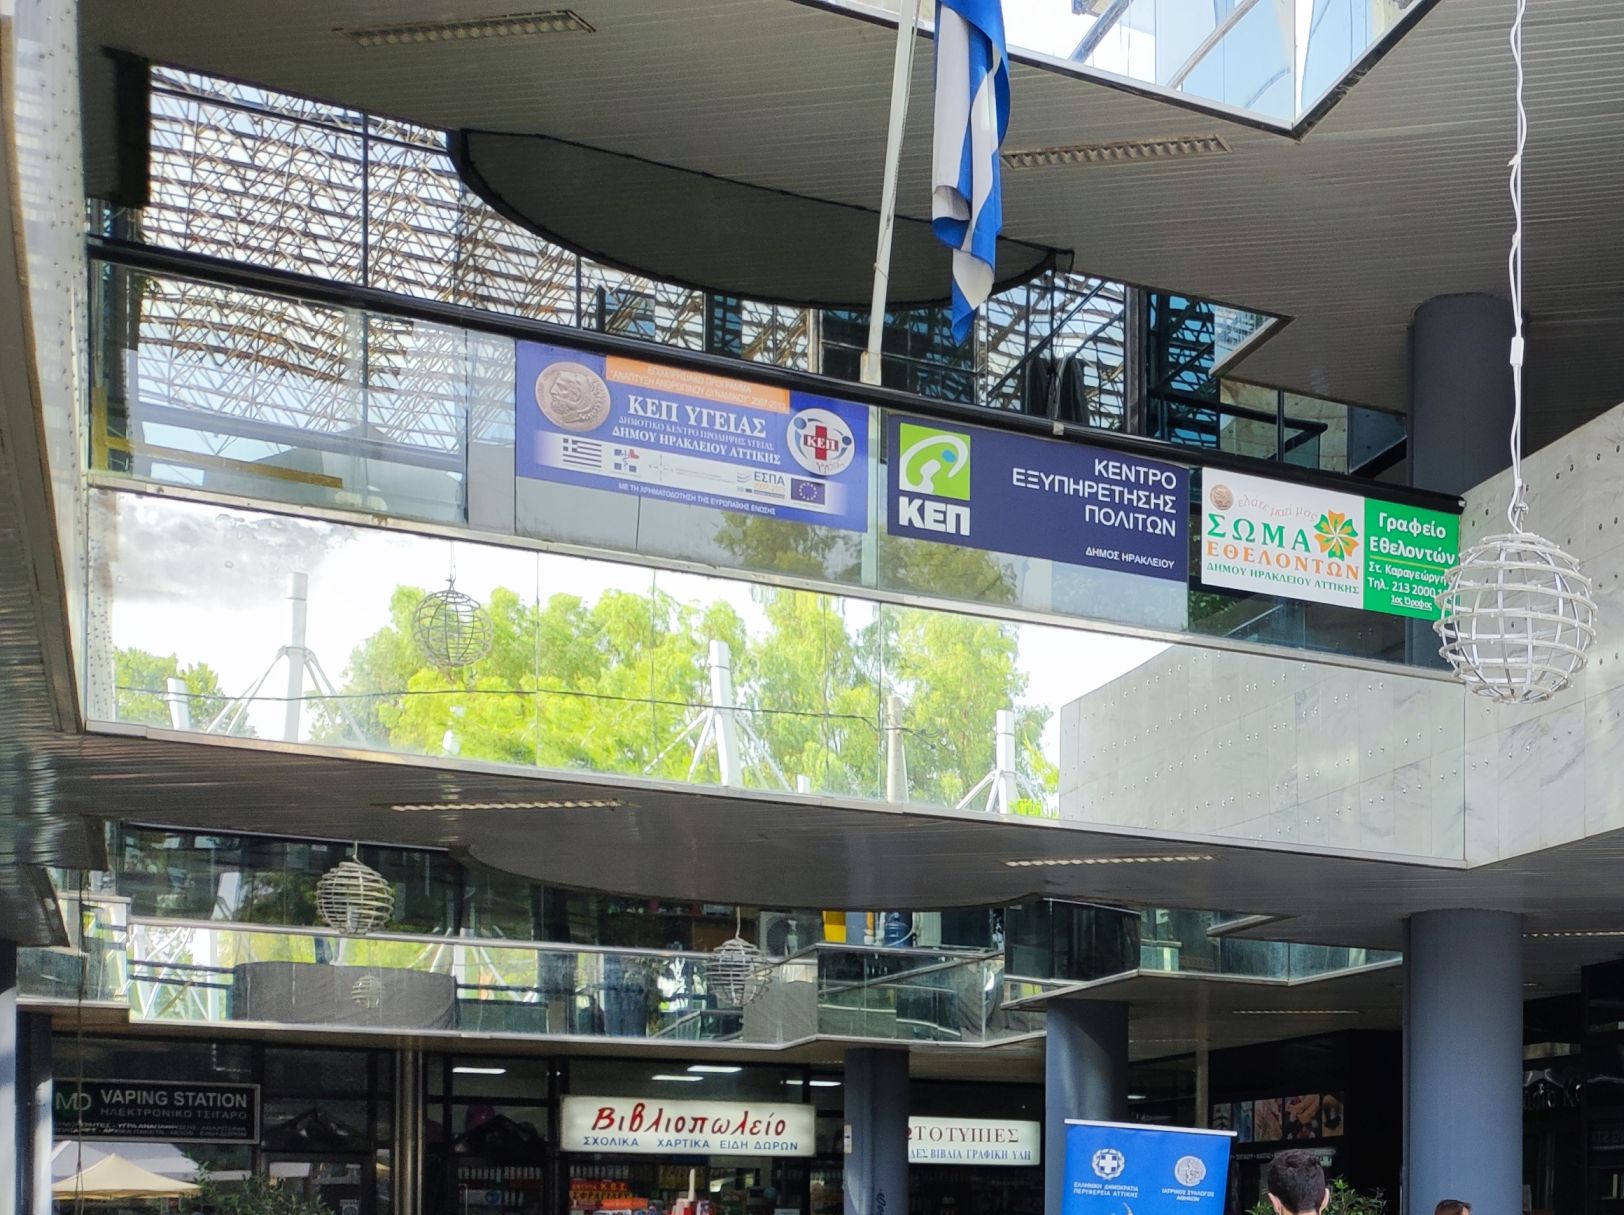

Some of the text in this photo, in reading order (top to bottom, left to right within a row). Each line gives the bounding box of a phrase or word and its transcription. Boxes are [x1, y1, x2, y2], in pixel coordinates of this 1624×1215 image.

[628, 394, 766, 438] ΚΕΠ ΥΓΕΙΑΣ
[612, 425, 781, 465] ΔΗΜΟΥ ΗΡΑΚΛΕΙΟΥ ΑΤΤΙΚΗΣ
[618, 415, 665, 431] ΔΗΜΟΤΙΚΟ
[665, 422, 699, 438] ΚΕΝΤΡΟ
[747, 437, 774, 451] ΥΓΕΙΑΣ
[807, 436, 836, 450] ΚΕΠ
[754, 471, 785, 486] ΕΣΠΑ
[1094, 458, 1177, 490] ΚΕΝΤΡΟ
[1012, 467, 1177, 513] ΕΞΥΠΗΡΕΤΗΣΗΣ
[899, 496, 970, 536] ΚΕΠ
[1085, 505, 1176, 537] ΠΟΛΙΤΩΝ
[1379, 512, 1446, 539] Γραφείο
[1207, 513, 1311, 553] ΣΩΜΑ
[1085, 547, 1175, 569] ΔΗΜΟΣ ΗΡΑΚΛΕΙΟΥ
[1207, 541, 1360, 580] ΕΘΕΛΟΝΤΩΝ
[1370, 536, 1456, 565] Εθελοντών
[1207, 562, 1360, 594] ΔΗΜΟΥ ΗΡΑΚΛΕΙΟΥ ΑΤΤΙΚΗΣ
[1368, 561, 1382, 573] Στ.
[1368, 577, 1389, 591] Τηλ.
[1392, 581, 1410, 593] 213
[1412, 584, 1436, 597] 2000
[100, 1089, 168, 1105] VAPING
[173, 1091, 247, 1108] STATION
[100, 1108, 248, 1120] ΗΛΕΚΤΡΟΝΙΚΟ ΤΣΙΓΑΡΟ
[591, 1102, 786, 1136] Βιβλιοπωλείο
[583, 1136, 798, 1151] ΣΧΟΛΙΚΑ ΧΑΡΤΙΚΑ ΕΙΔΗ ΔΩΡΩΝ
[930, 1149, 962, 1159] ΒΙΒΛΙΑ
[966, 1149, 1008, 1160] ΓΡΑΦΙΚΗ
[1012, 1150, 1032, 1161] ΥΛΗ
[1113, 1190, 1138, 1198] ΑΤΤΙΚΗΣ
